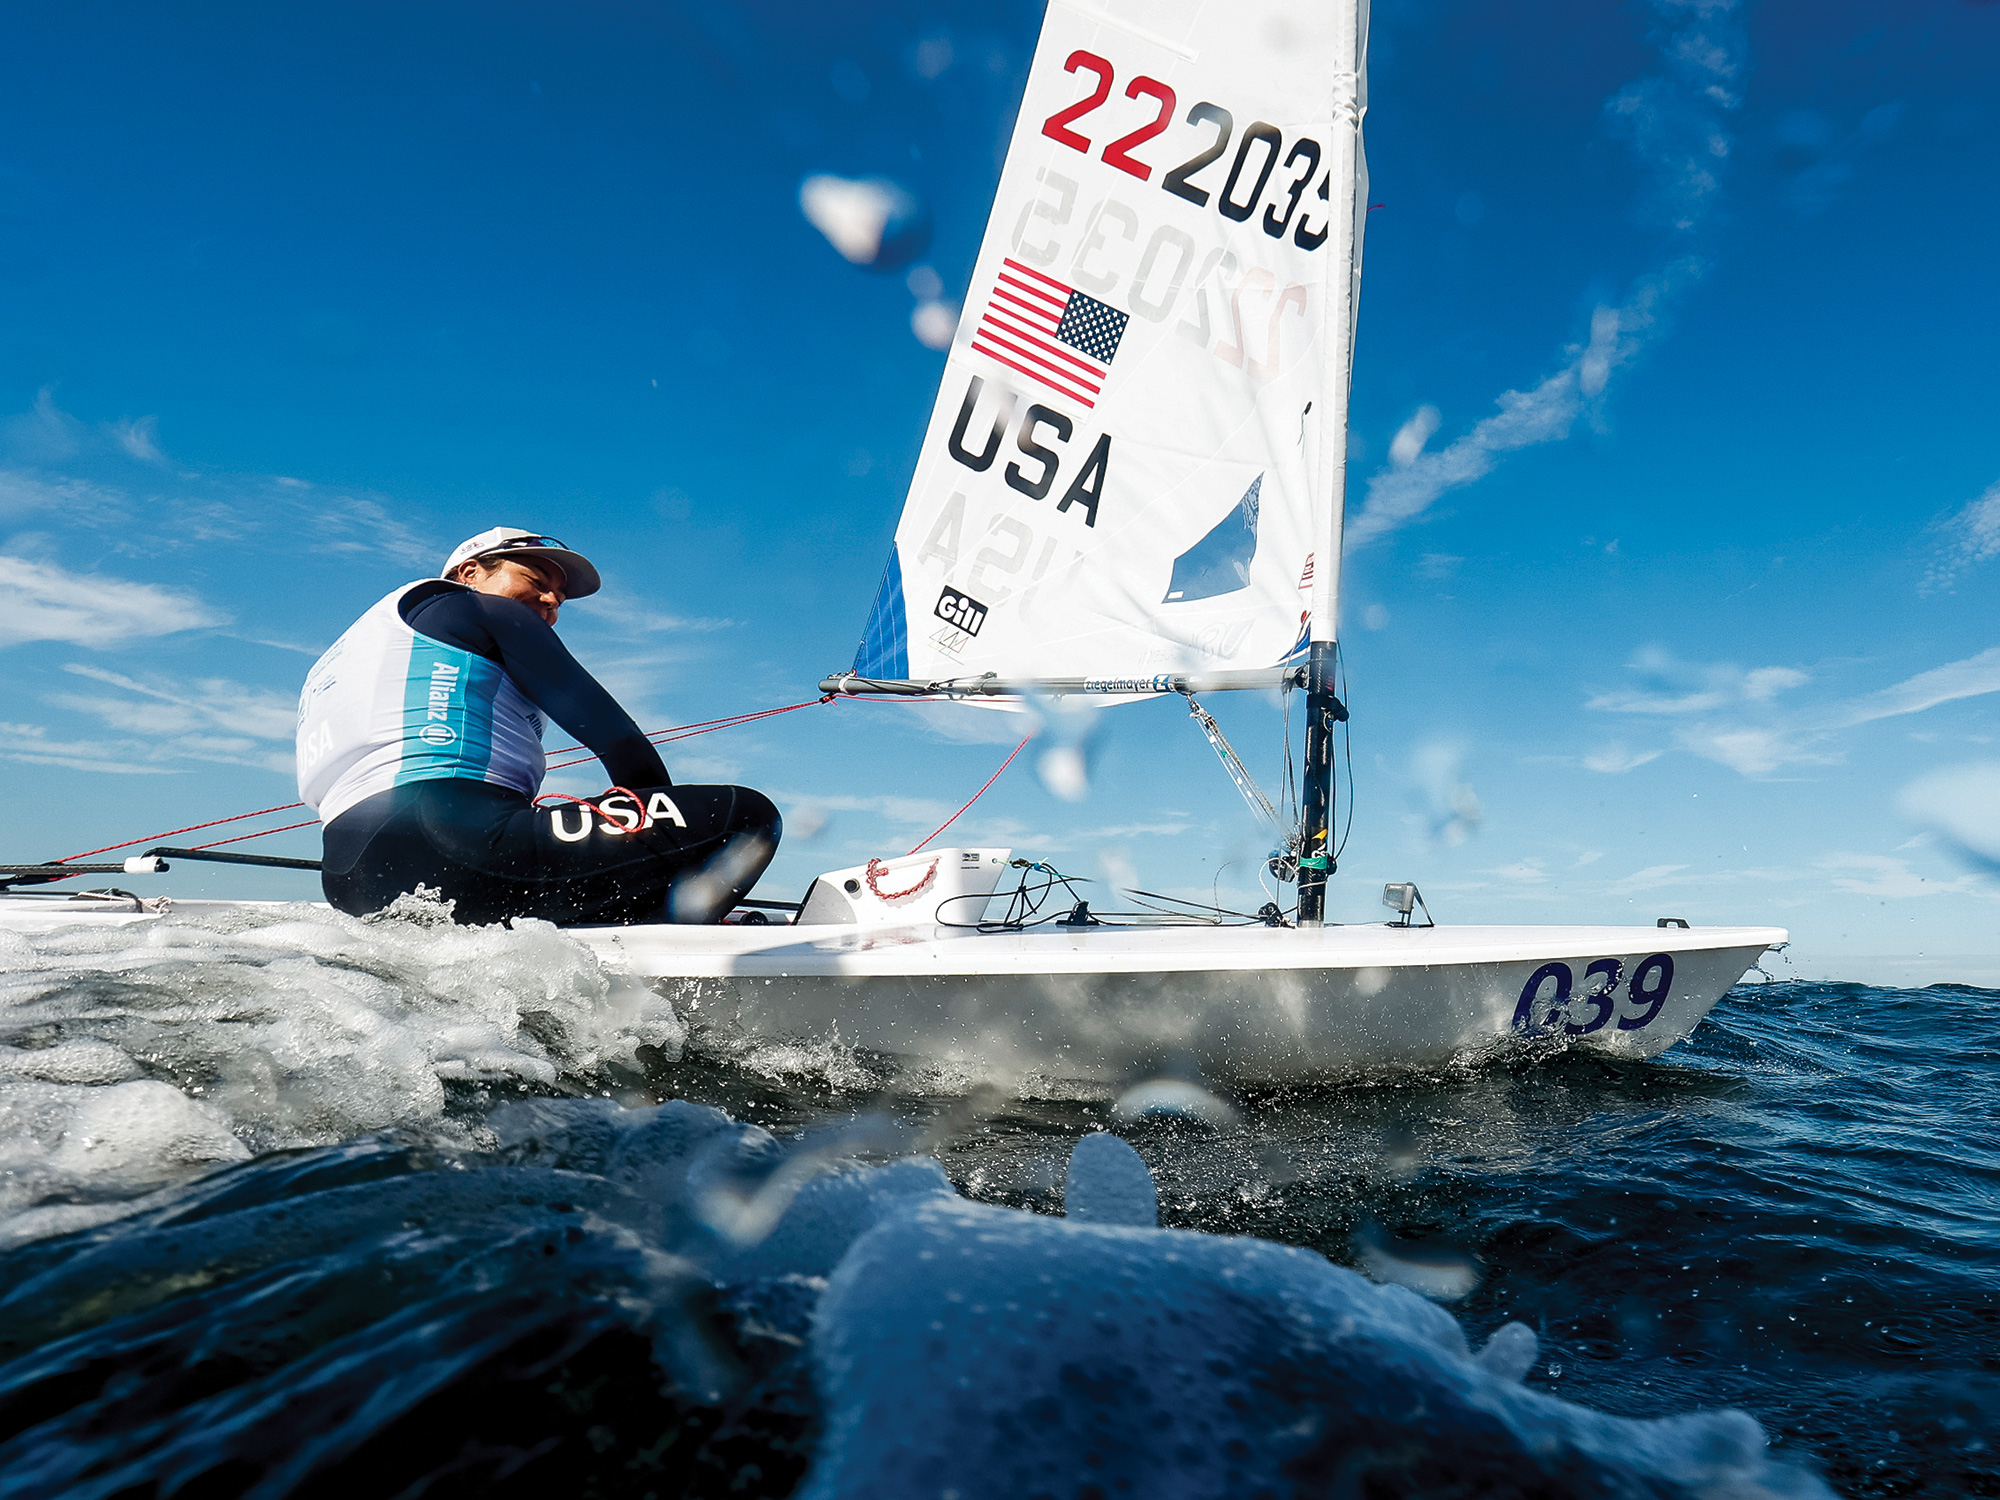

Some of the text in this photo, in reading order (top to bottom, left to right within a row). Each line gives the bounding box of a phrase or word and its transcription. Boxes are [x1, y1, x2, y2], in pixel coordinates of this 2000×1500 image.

[948, 375, 1111, 528] USA
[938, 595, 984, 636] Gill
[427, 662, 460, 721] Allianz
[1085, 675, 1151, 692] ziegelmayer
[300, 720, 334, 778] USA
[525, 712, 543, 743] Allian
[550, 792, 687, 842] USA
[1511, 953, 1675, 1038] 039
